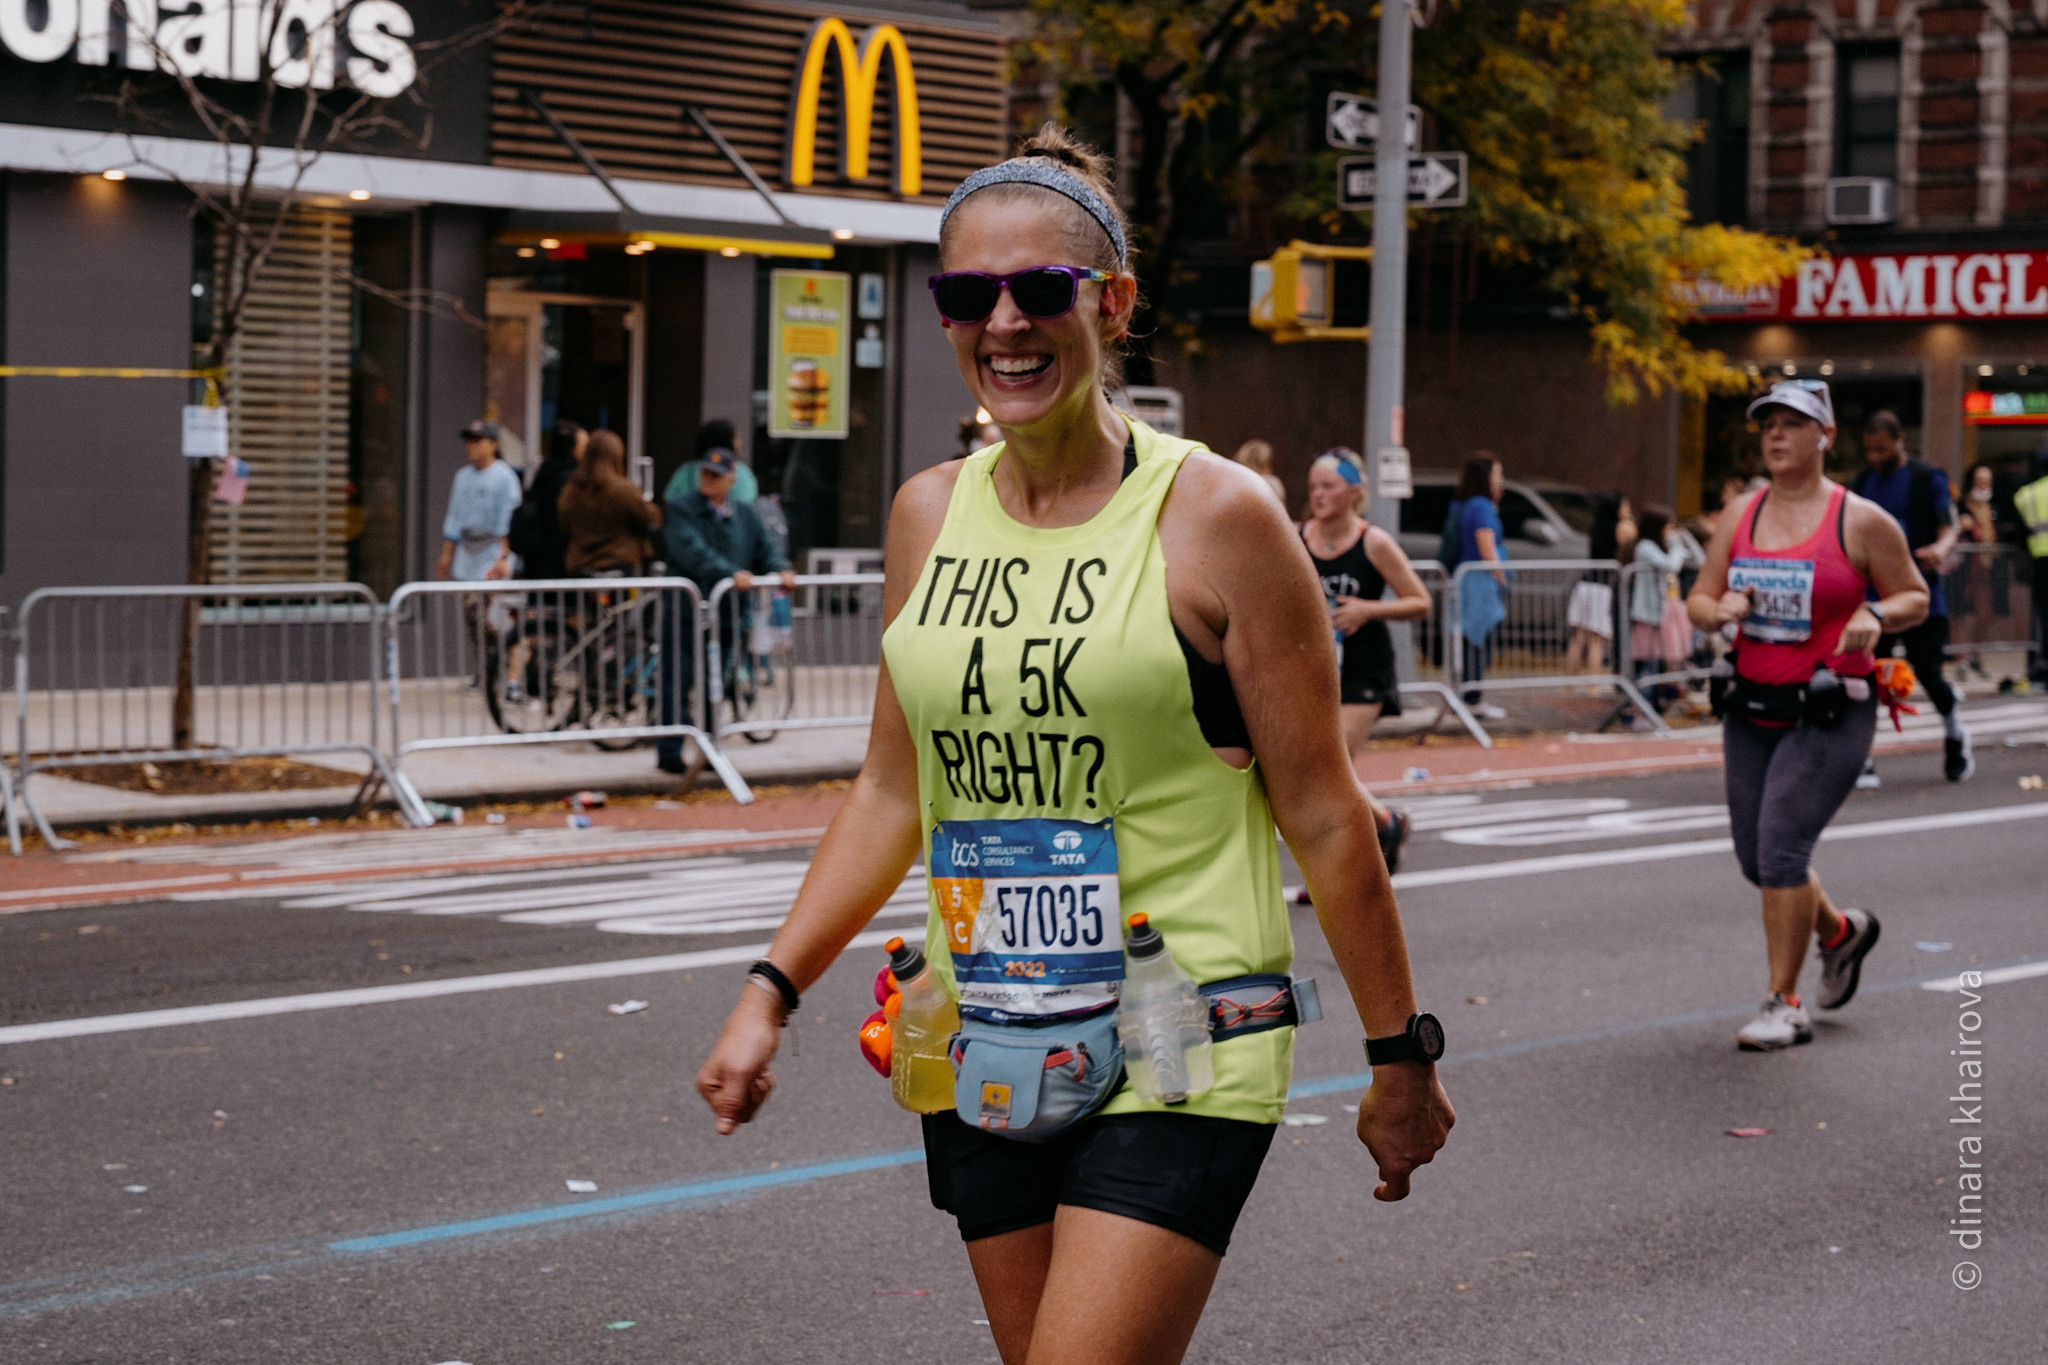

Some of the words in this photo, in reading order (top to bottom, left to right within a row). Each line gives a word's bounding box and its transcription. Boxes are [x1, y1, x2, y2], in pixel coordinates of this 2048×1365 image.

[1792, 253, 2048, 317] FAMIGL
[917, 555, 1030, 628] THIS
[1049, 557, 1107, 625] IS
[961, 636, 992, 716] A
[1019, 636, 1088, 718] 5K
[931, 729, 1106, 810] RIGHT?
[951, 837, 980, 868] tcs
[980, 835, 1003, 845] TATA
[1049, 852, 1087, 866] TATA
[954, 920, 969, 944] C
[997, 884, 1104, 948] 57035
[1004, 960, 1047, 978] 2022
